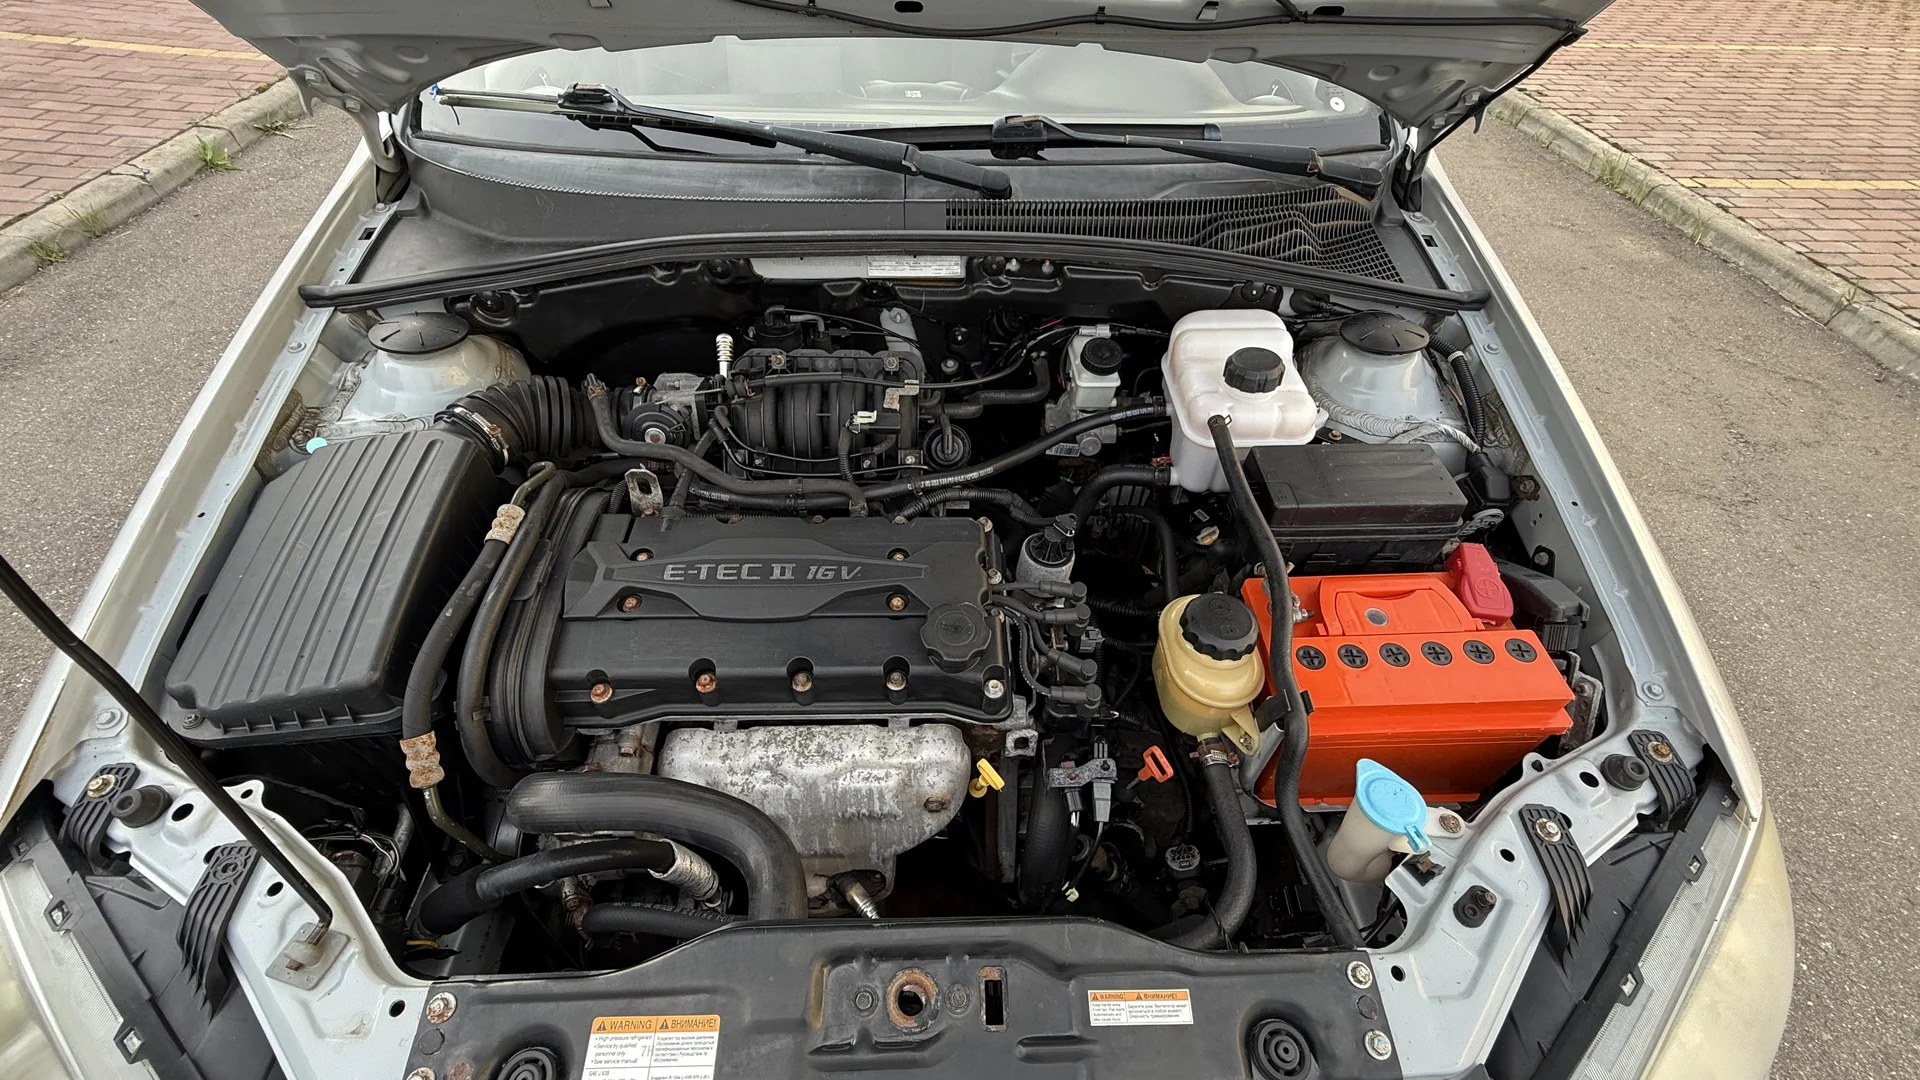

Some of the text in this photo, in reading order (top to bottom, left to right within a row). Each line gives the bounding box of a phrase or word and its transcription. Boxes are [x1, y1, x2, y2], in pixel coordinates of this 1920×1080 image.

[663, 563, 763, 581] E-TEC
[609, 1019, 652, 1031] WARNING
[670, 1018, 717, 1029] ВНИМАНИЕ!
